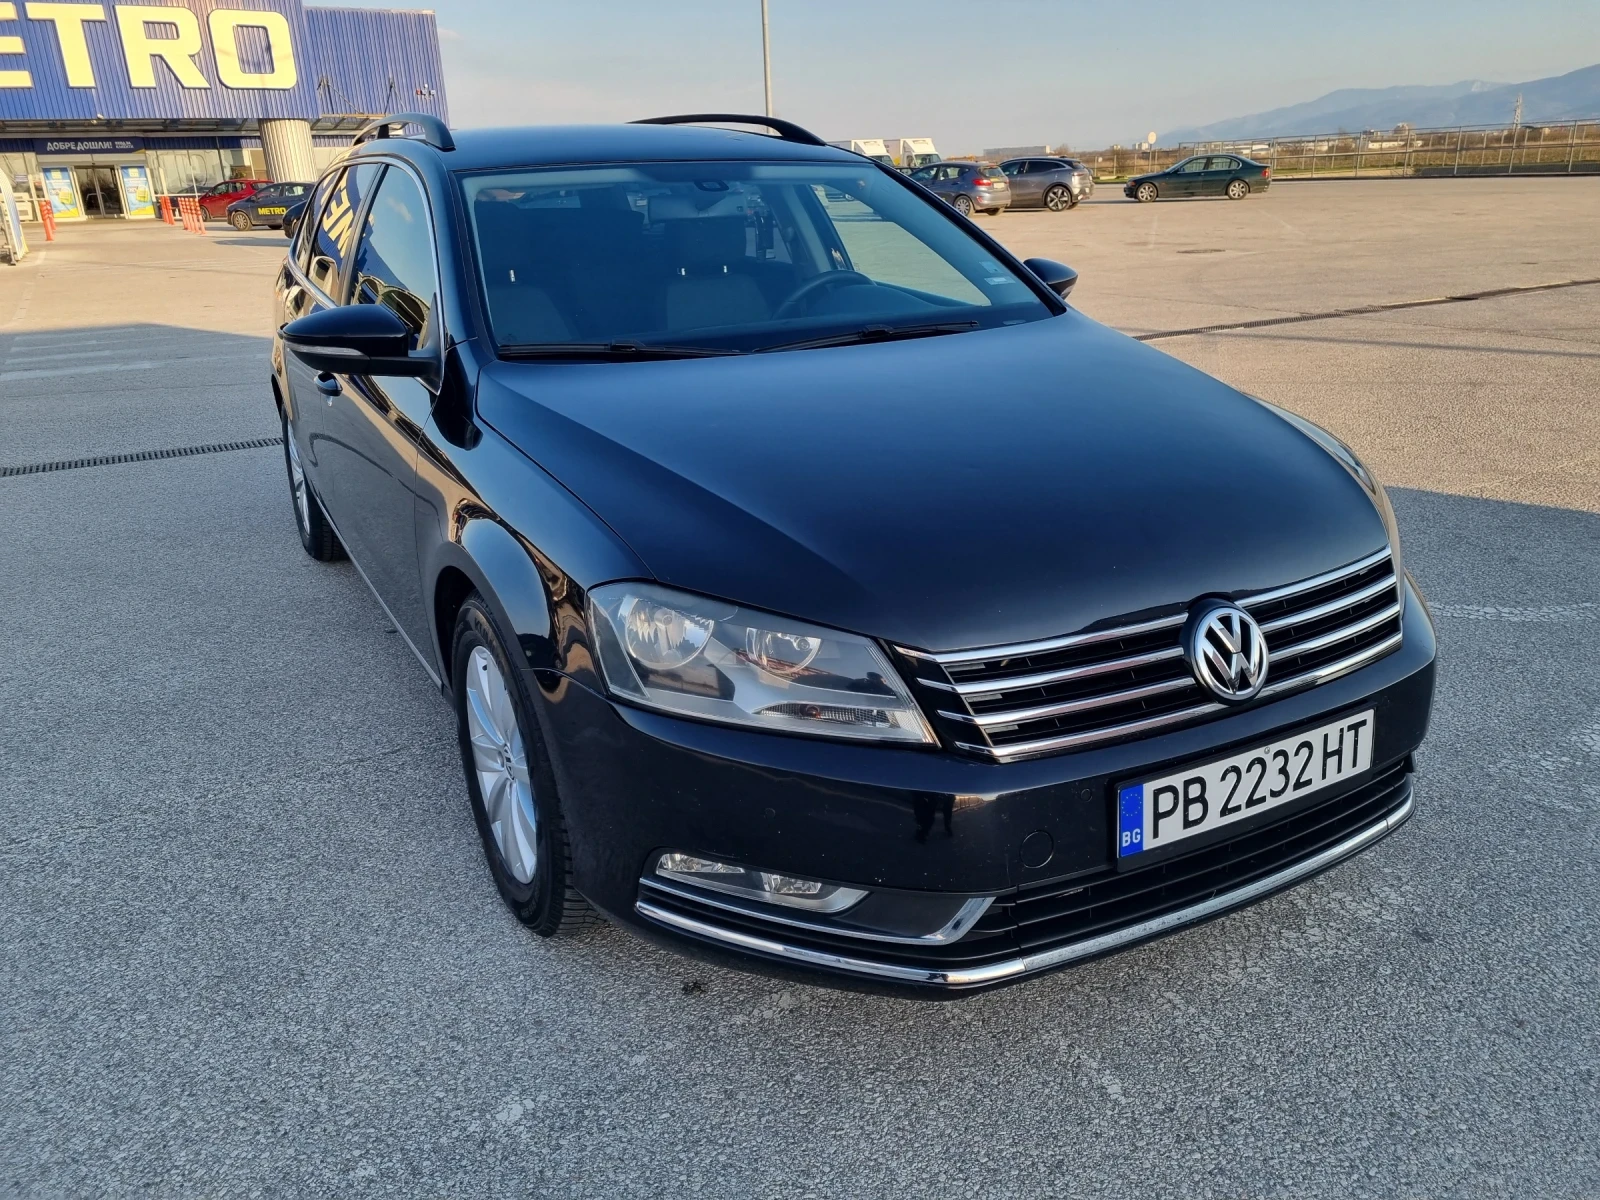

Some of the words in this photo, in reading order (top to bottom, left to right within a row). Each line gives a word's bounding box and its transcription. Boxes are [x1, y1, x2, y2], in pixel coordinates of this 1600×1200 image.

[47, 141, 76, 151] ДОБРЕ
[77, 140, 113, 151] ДОШЛИ!
[257, 206, 287, 216] METRO
[1219, 740, 1314, 818] 2232
[1121, 828, 1141, 847] BG
